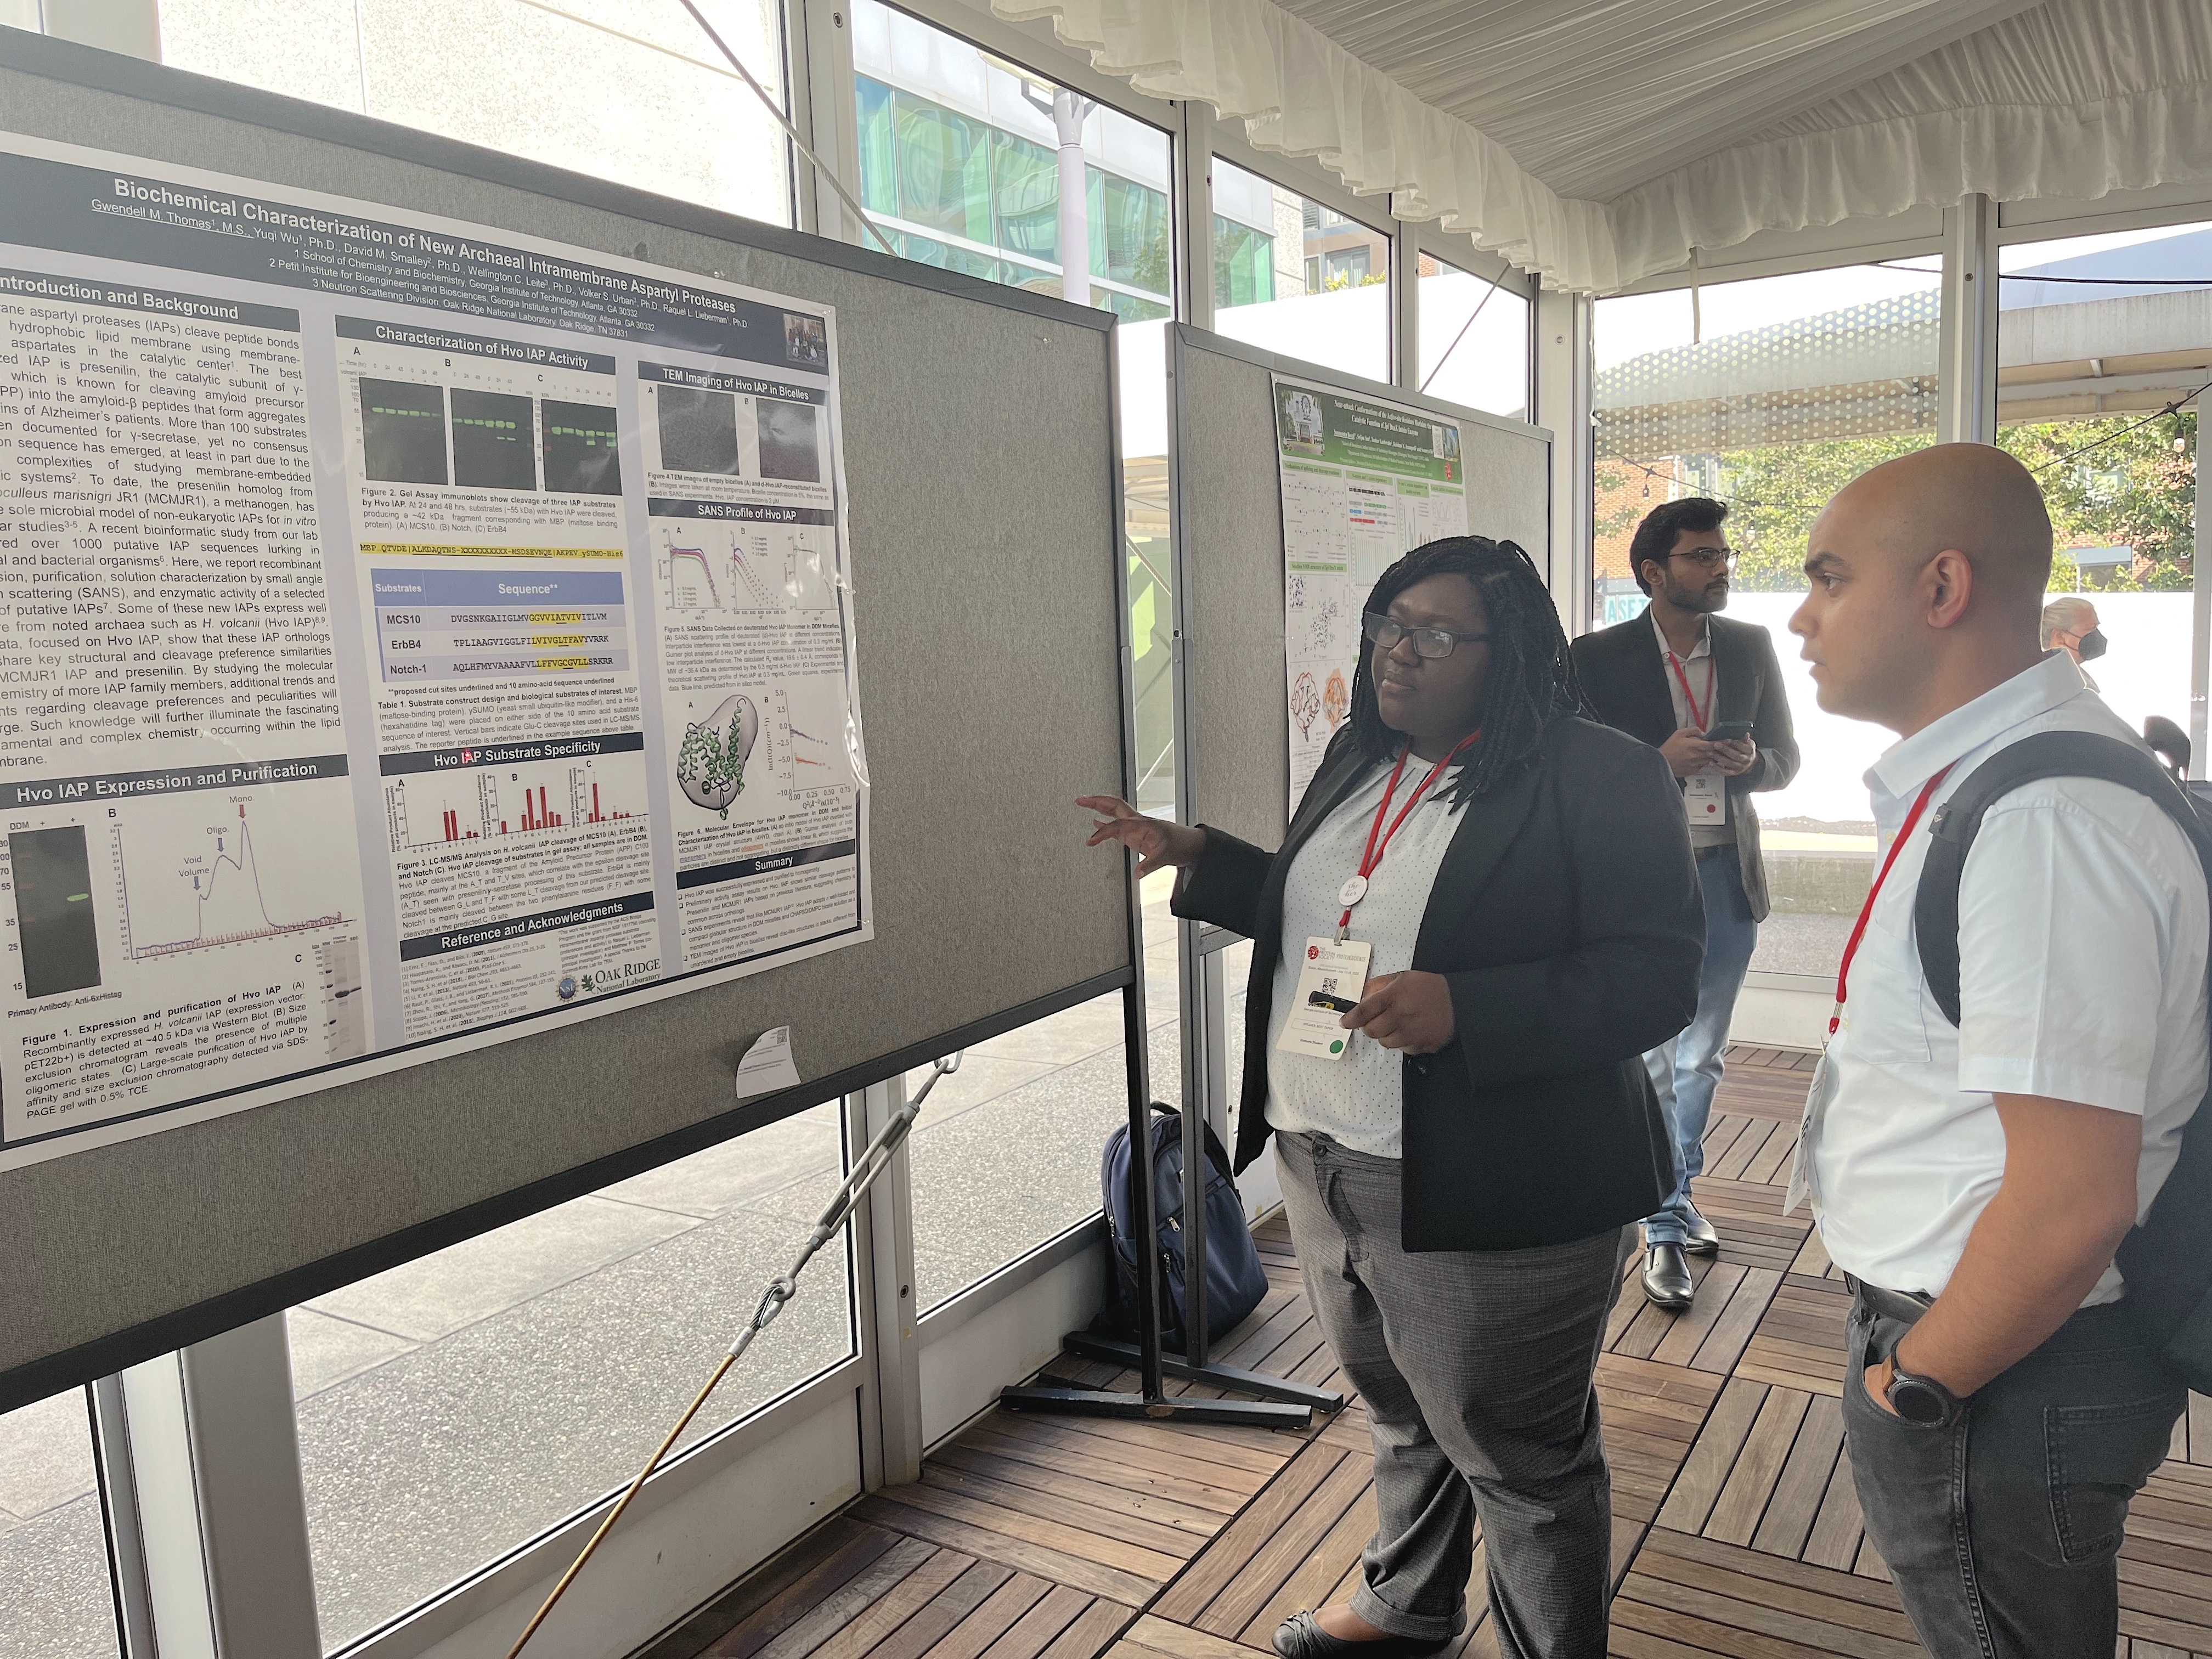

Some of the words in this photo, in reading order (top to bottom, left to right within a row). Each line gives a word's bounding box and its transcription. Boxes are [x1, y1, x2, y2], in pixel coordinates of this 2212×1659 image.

[115, 178, 236, 217] Biochemical
[244, 201, 392, 244] Characterization
[399, 232, 415, 249] of
[420, 234, 454, 256] New
[459, 242, 524, 269] Archaeal
[529, 256, 627, 290] Intramembrane
[631, 278, 678, 303] Aspartyl
[682, 289, 735, 313] Proteases
[108, 291, 137, 306] and
[143, 293, 238, 320] Background
[376, 325, 482, 353] Characterization
[486, 342, 498, 354] of
[501, 343, 523, 359] Hvo
[527, 348, 545, 363] IAP
[549, 352, 588, 371] Activity
[663, 368, 682, 382] TEM
[686, 371, 721, 390] Imaging
[725, 377, 733, 389] of
[736, 378, 752, 391] Hvo
[754, 380, 768, 393] IAP
[770, 382, 777, 395] in
[779, 384, 809, 400] Bicelles
[362, 488, 386, 497] Figure
[416, 492, 438, 501] Assay
[442, 493, 487, 501] immunoblots
[511, 496, 539, 506] cleavage
[698, 505, 723, 517] SANS
[726, 506, 753, 518] Profile
[755, 507, 763, 519] of
[765, 508, 781, 520] Hvo
[783, 509, 796, 521] IAP
[9, 588, 71, 602] scattering
[78, 588, 128, 602] (SANS),
[134, 587, 154, 599] and
[160, 588, 216, 601] enzymatic
[221, 588, 256, 601] activity
[261, 588, 269, 598] of
[284, 588, 324, 598] selected
[375, 583, 422, 593] Substrates
[31, 719, 62, 732] Such
[69, 715, 135, 729] knowledge
[142, 712, 160, 724] will
[166, 709, 204, 722] further
[210, 707, 260, 719] illuminate
[266, 705, 281, 716] the
[286, 702, 338, 714] fascinating
[435, 754, 458, 766] Hvo
[461, 751, 481, 764] IAP
[486, 746, 541, 762] Substrate
[545, 741, 600, 759] Specificity
[17, 787, 52, 803] Hvo
[59, 782, 88, 799] IAP
[96, 774, 191, 798] Expression
[198, 768, 226, 786] and
[232, 762, 317, 782] Purification
[10, 821, 29, 830] DDM
[206, 826, 230, 834] Oligo.
[183, 855, 202, 864] Void
[755, 856, 793, 871] Summary
[178, 868, 210, 877] Volume
[442, 929, 500, 949] Reference
[505, 923, 524, 938] and
[528, 903, 623, 932] Acknowledgments
[8, 943, 18, 951] 25
[595, 968, 622, 984] OAK
[624, 958, 661, 977] RIDGE
[13, 982, 22, 990] 15
[596, 980, 625, 994] National
[627, 973, 661, 986] Laboratory
[22, 1033, 55, 1046] Figure
[64, 1029, 71, 1037] 1.
[80, 1017, 136, 1034] Expression
[144, 1011, 160, 1021] and
[168, 1000, 221, 1017] purification
[228, 994, 236, 1003] of
[243, 991, 259, 1000] Hvo
[266, 986, 280, 996] IAP
[293, 980, 304, 992] (A)
